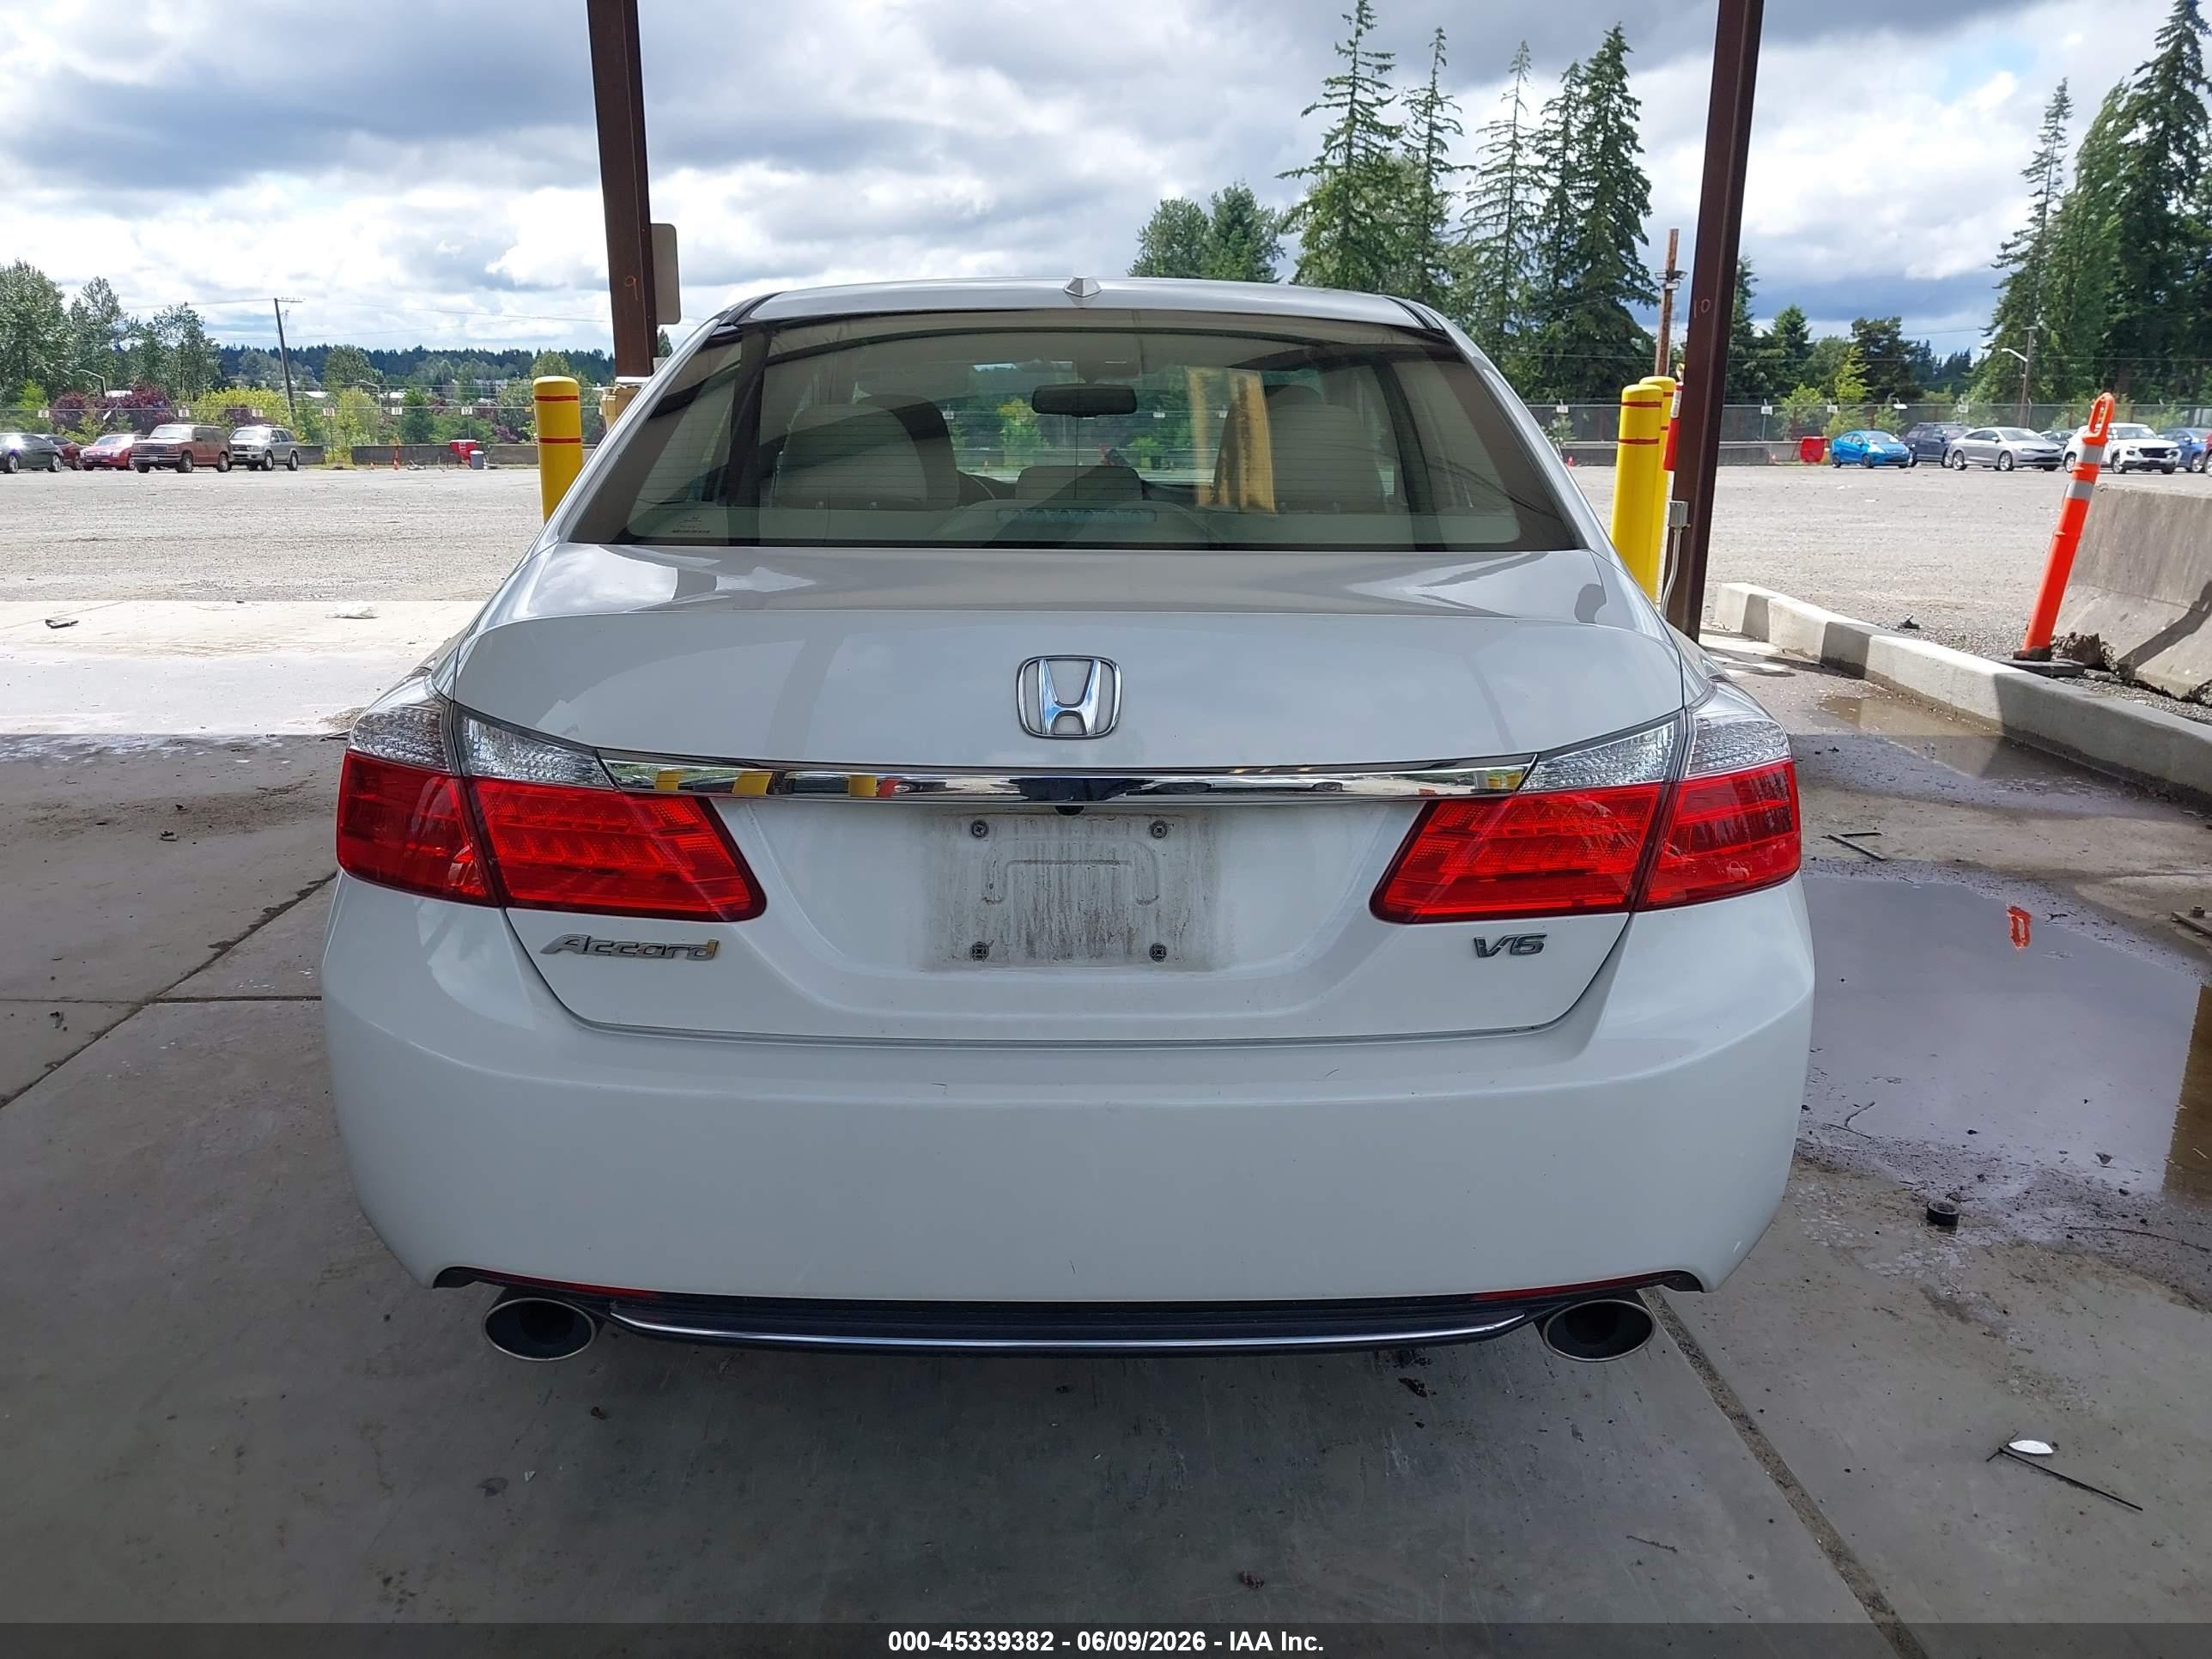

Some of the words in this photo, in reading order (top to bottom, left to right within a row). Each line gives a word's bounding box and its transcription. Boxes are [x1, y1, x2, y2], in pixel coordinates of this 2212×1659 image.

[623, 275, 639, 301] 9
[540, 933, 720, 961] Accord
[1474, 932, 1548, 957] V6
